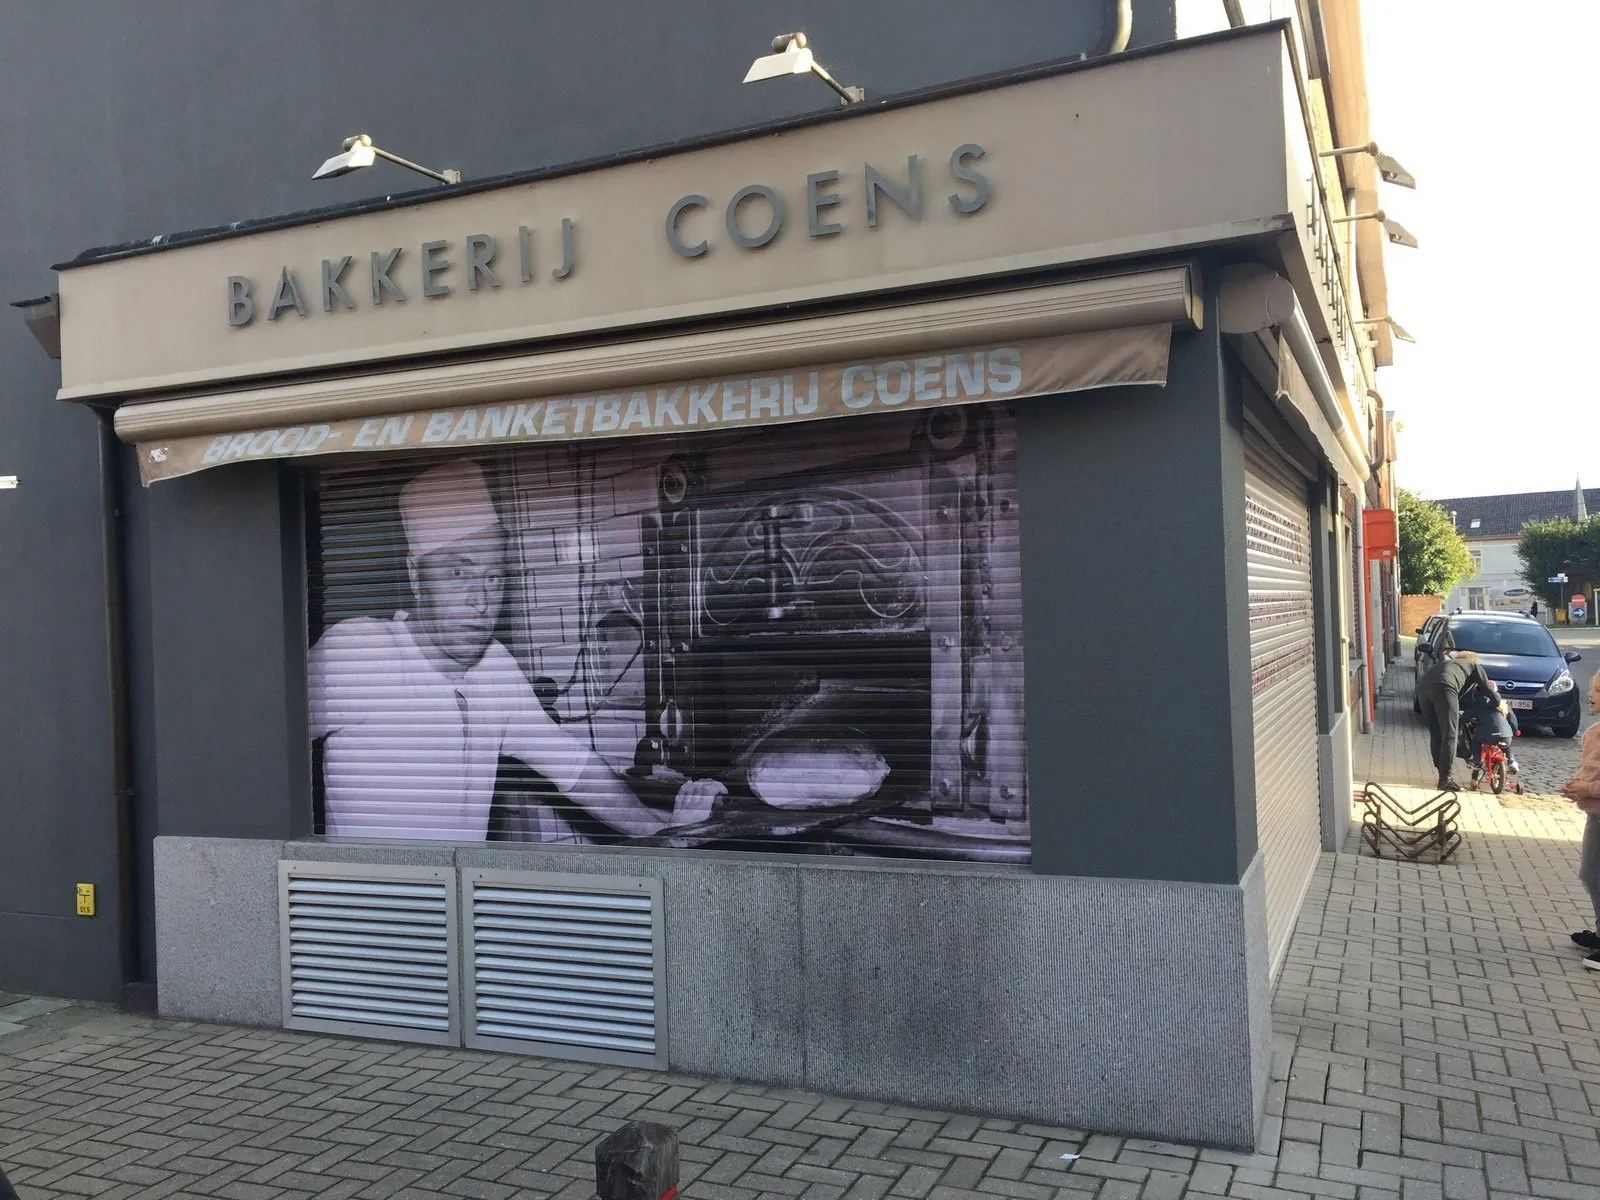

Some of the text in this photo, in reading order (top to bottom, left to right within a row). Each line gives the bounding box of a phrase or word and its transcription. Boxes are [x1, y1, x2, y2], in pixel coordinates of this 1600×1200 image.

[227, 143, 990, 327] BAKKERIJ COENS
[203, 347, 1023, 464] BROOD- EN BANKETBAKKERIJ COENS
